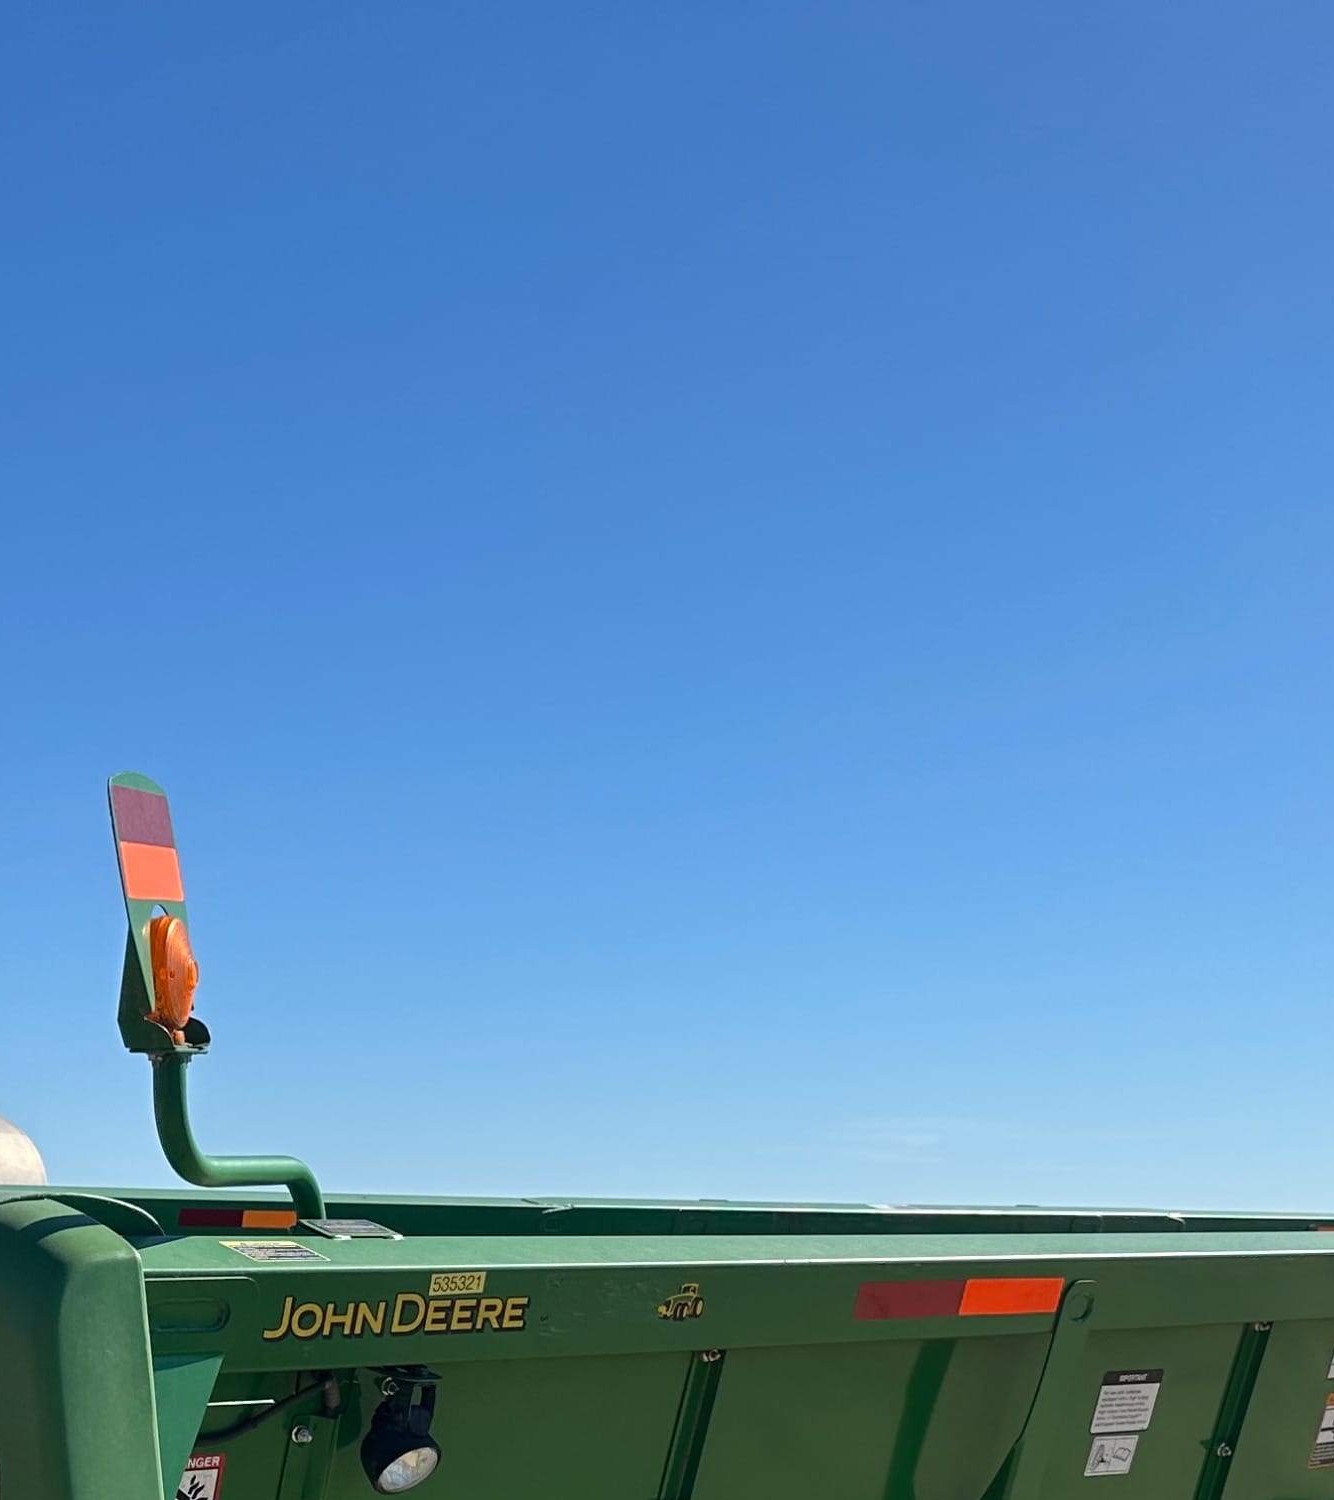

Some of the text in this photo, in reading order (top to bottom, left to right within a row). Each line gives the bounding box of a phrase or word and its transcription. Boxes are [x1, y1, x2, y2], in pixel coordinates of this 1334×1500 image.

[433, 1275, 481, 1292] 535321
[262, 1293, 529, 1341] JOHN DEERE
[186, 1456, 220, 1469] NGER
